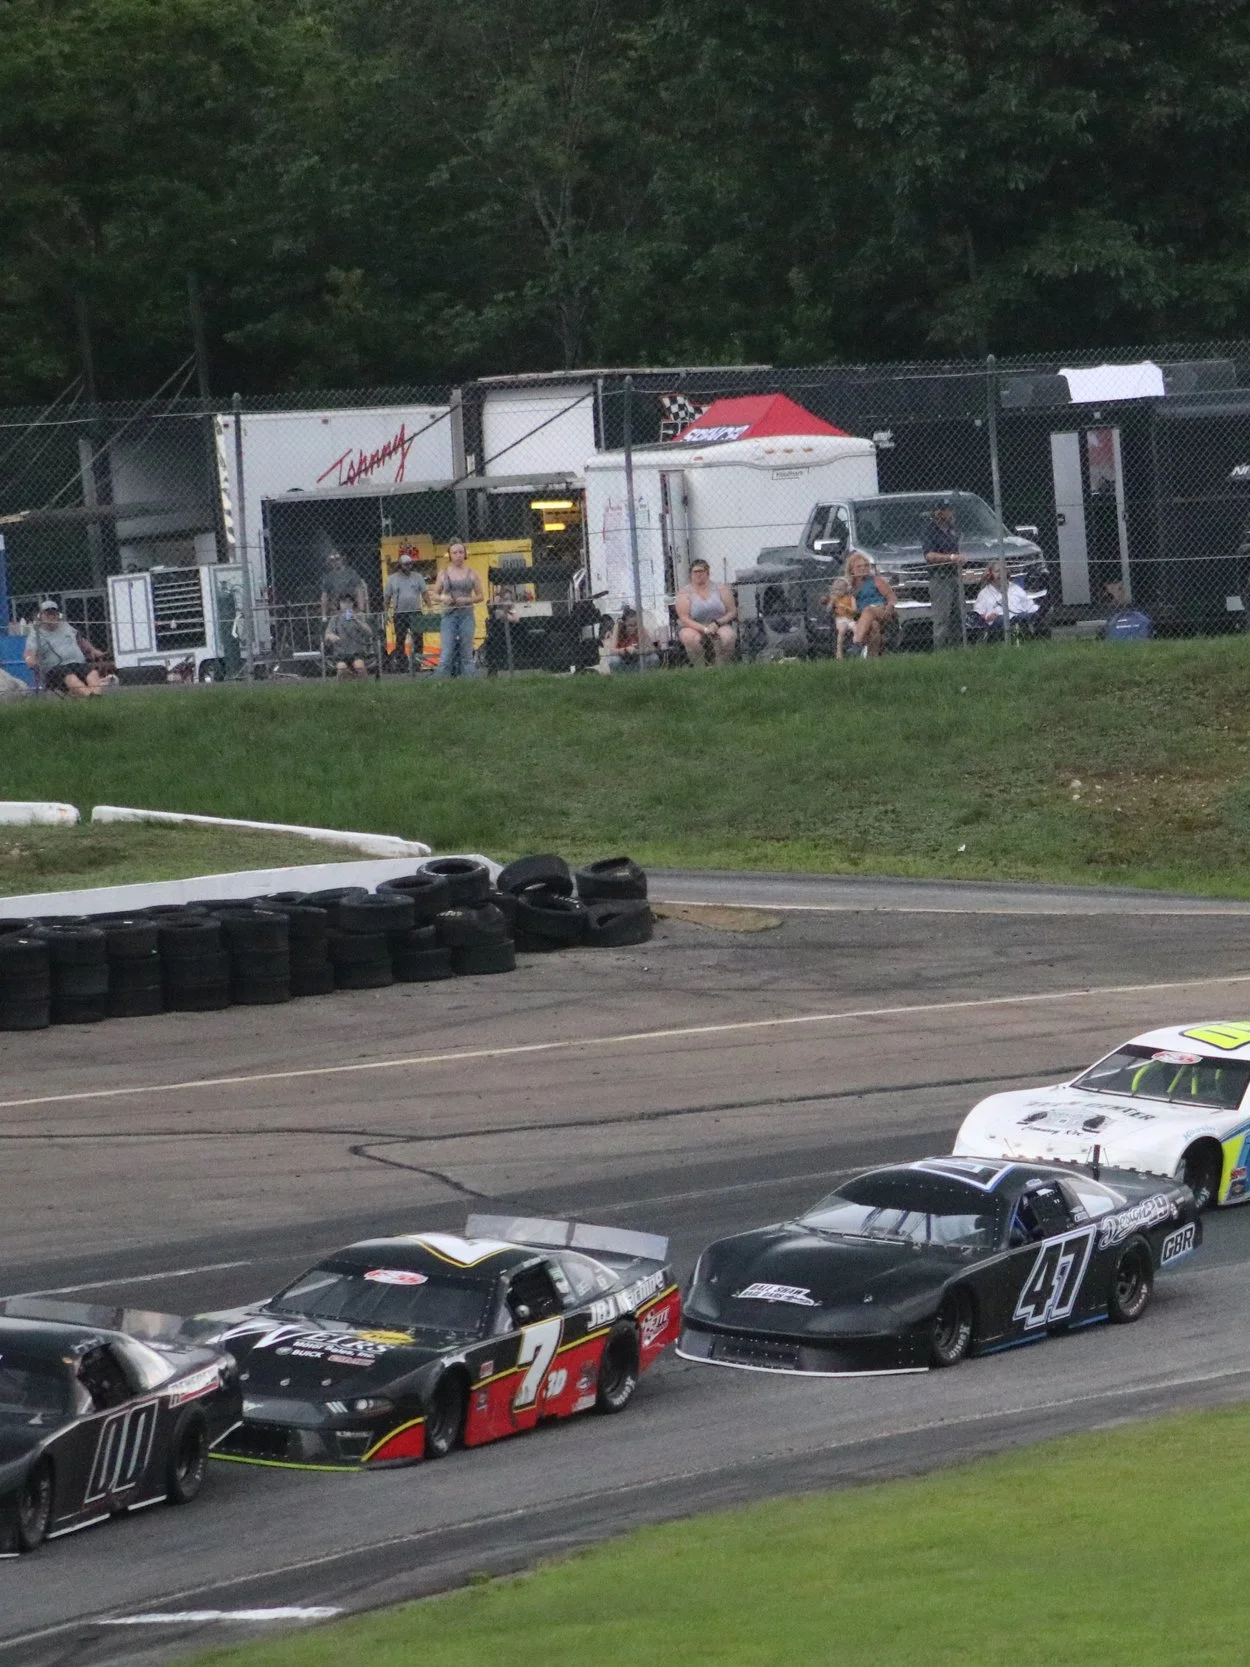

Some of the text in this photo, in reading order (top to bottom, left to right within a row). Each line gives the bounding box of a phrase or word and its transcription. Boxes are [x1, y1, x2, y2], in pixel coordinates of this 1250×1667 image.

[1162, 1226, 1194, 1261] GBR
[1012, 1224, 1097, 1331] 47
[291, 1349, 325, 1358] BUICK
[292, 1340, 323, 1350] Motor
[512, 1315, 564, 1414] 7
